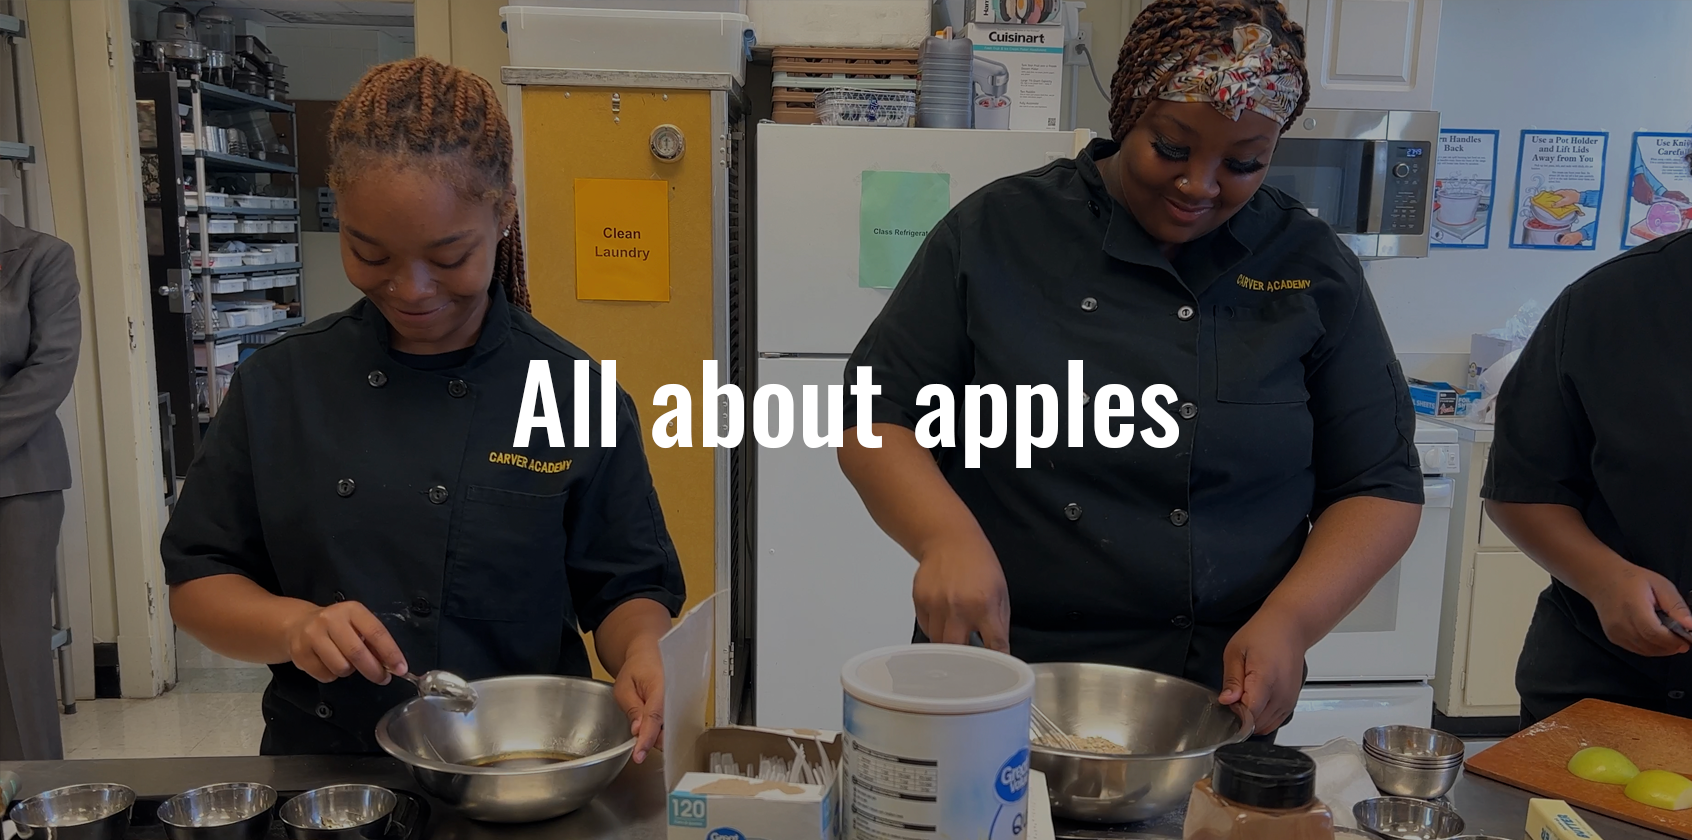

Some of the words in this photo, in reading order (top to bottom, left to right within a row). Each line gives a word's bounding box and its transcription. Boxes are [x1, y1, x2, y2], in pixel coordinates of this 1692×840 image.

[988, 31, 1045, 44] Cuisinart
[1449, 135, 1482, 143] Handles
[1531, 136, 1547, 144] Use
[1555, 136, 1569, 145] Pot
[1570, 136, 1599, 145] Holder
[1656, 138, 1671, 147] Use
[1444, 144, 1464, 152] Back
[1538, 145, 1554, 153] and
[1556, 145, 1571, 153] Lift
[1572, 146, 1590, 154] Lids
[1532, 154, 1555, 164] Away
[1557, 154, 1577, 163] from
[1579, 154, 1594, 163] You
[603, 227, 641, 239] Clean
[595, 246, 650, 261] Laundry
[1237, 274, 1264, 290] CARVER
[1267, 280, 1311, 292] ACADEMY
[1416, 400, 1435, 409] SHEETS
[489, 452, 528, 469] CARVER
[528, 459, 573, 474] ACADEMY
[672, 799, 705, 818] 120
[1557, 814, 1590, 839] BUTTER
